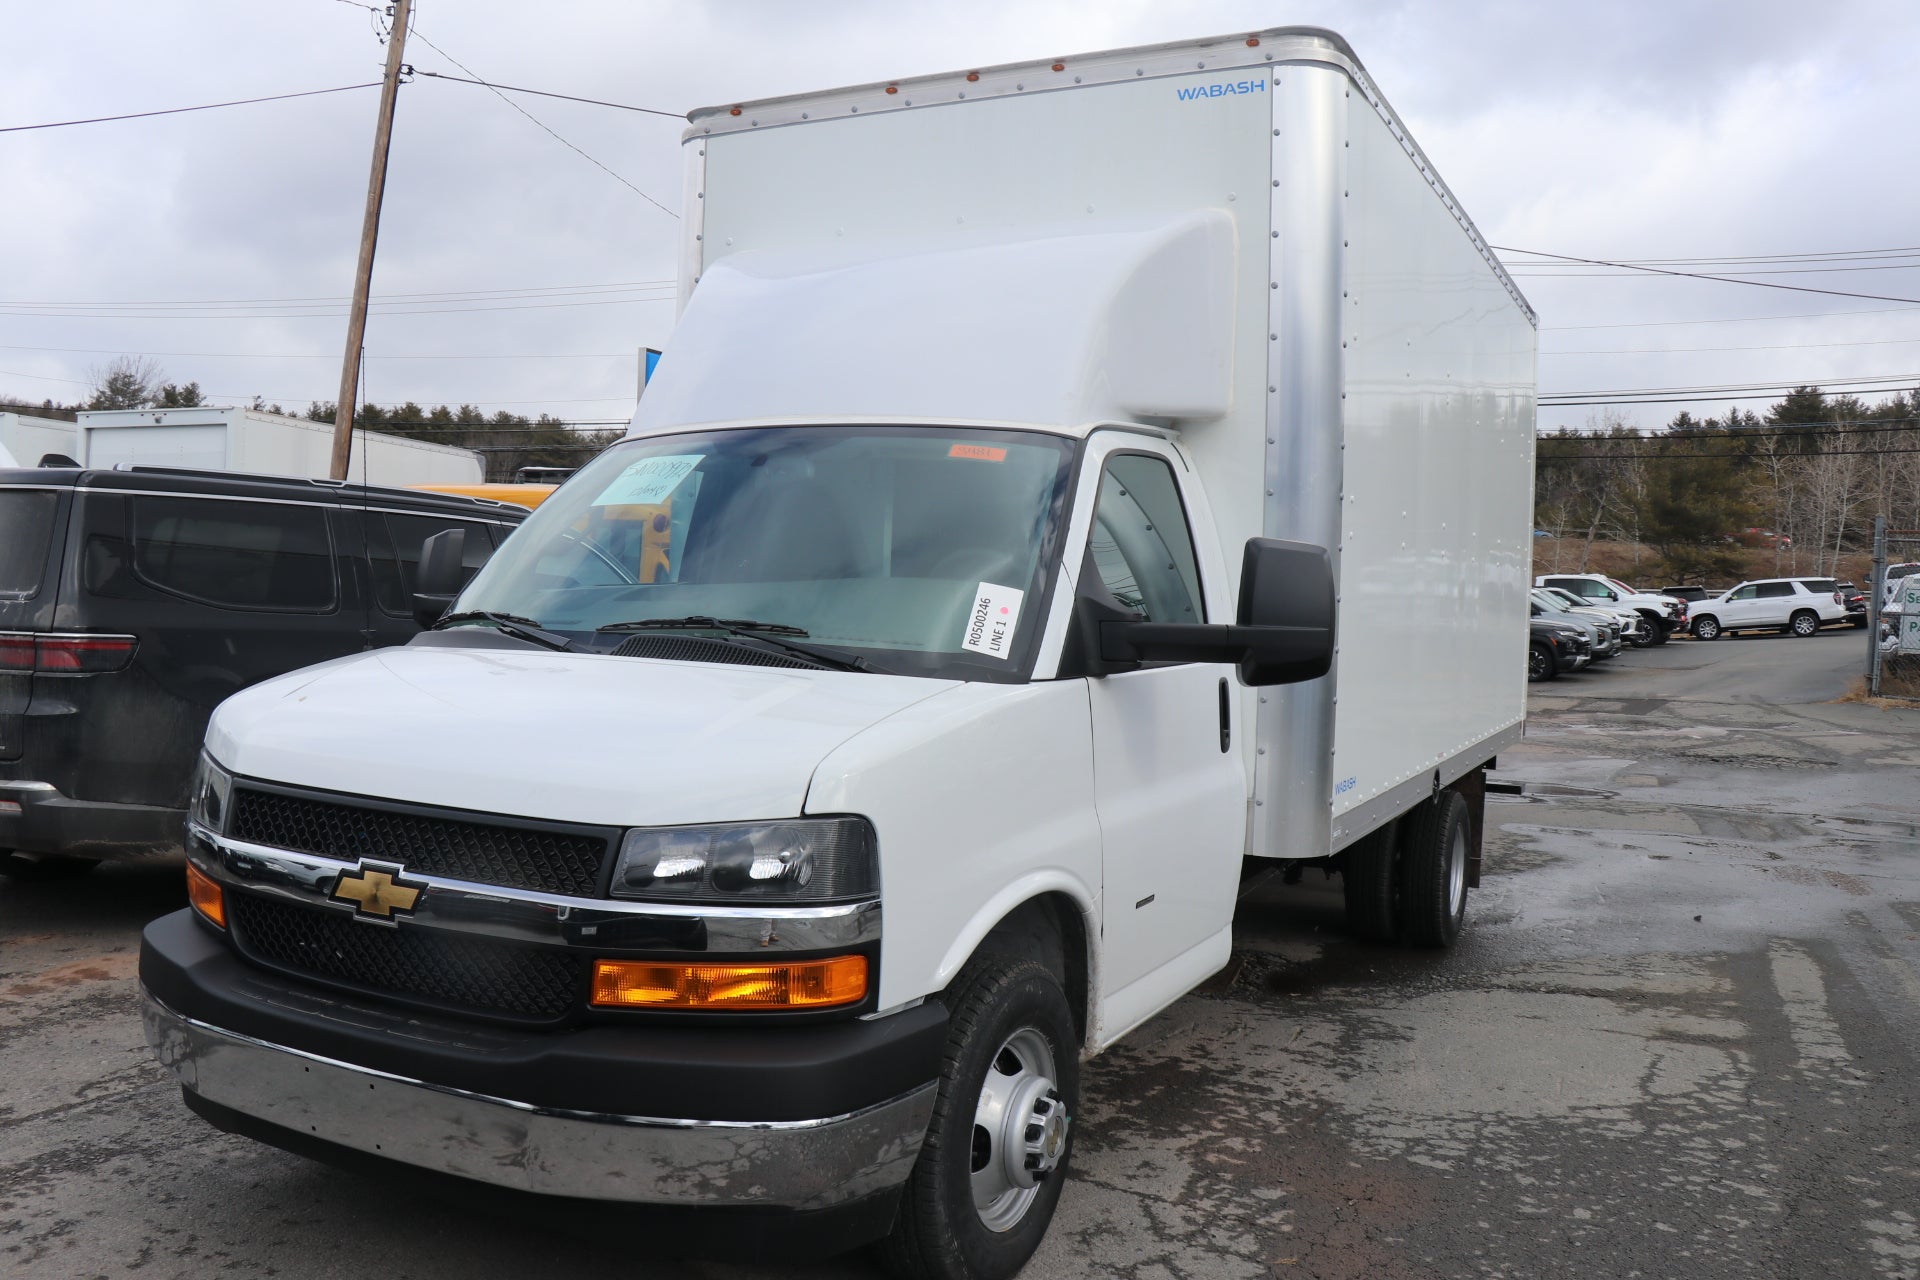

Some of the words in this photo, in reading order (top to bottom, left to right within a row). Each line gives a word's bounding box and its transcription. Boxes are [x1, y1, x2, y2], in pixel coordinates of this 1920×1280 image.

[1177, 80, 1265, 101] WABASH
[989, 629, 1004, 651] LINE
[1335, 776, 1357, 795] WABASH
